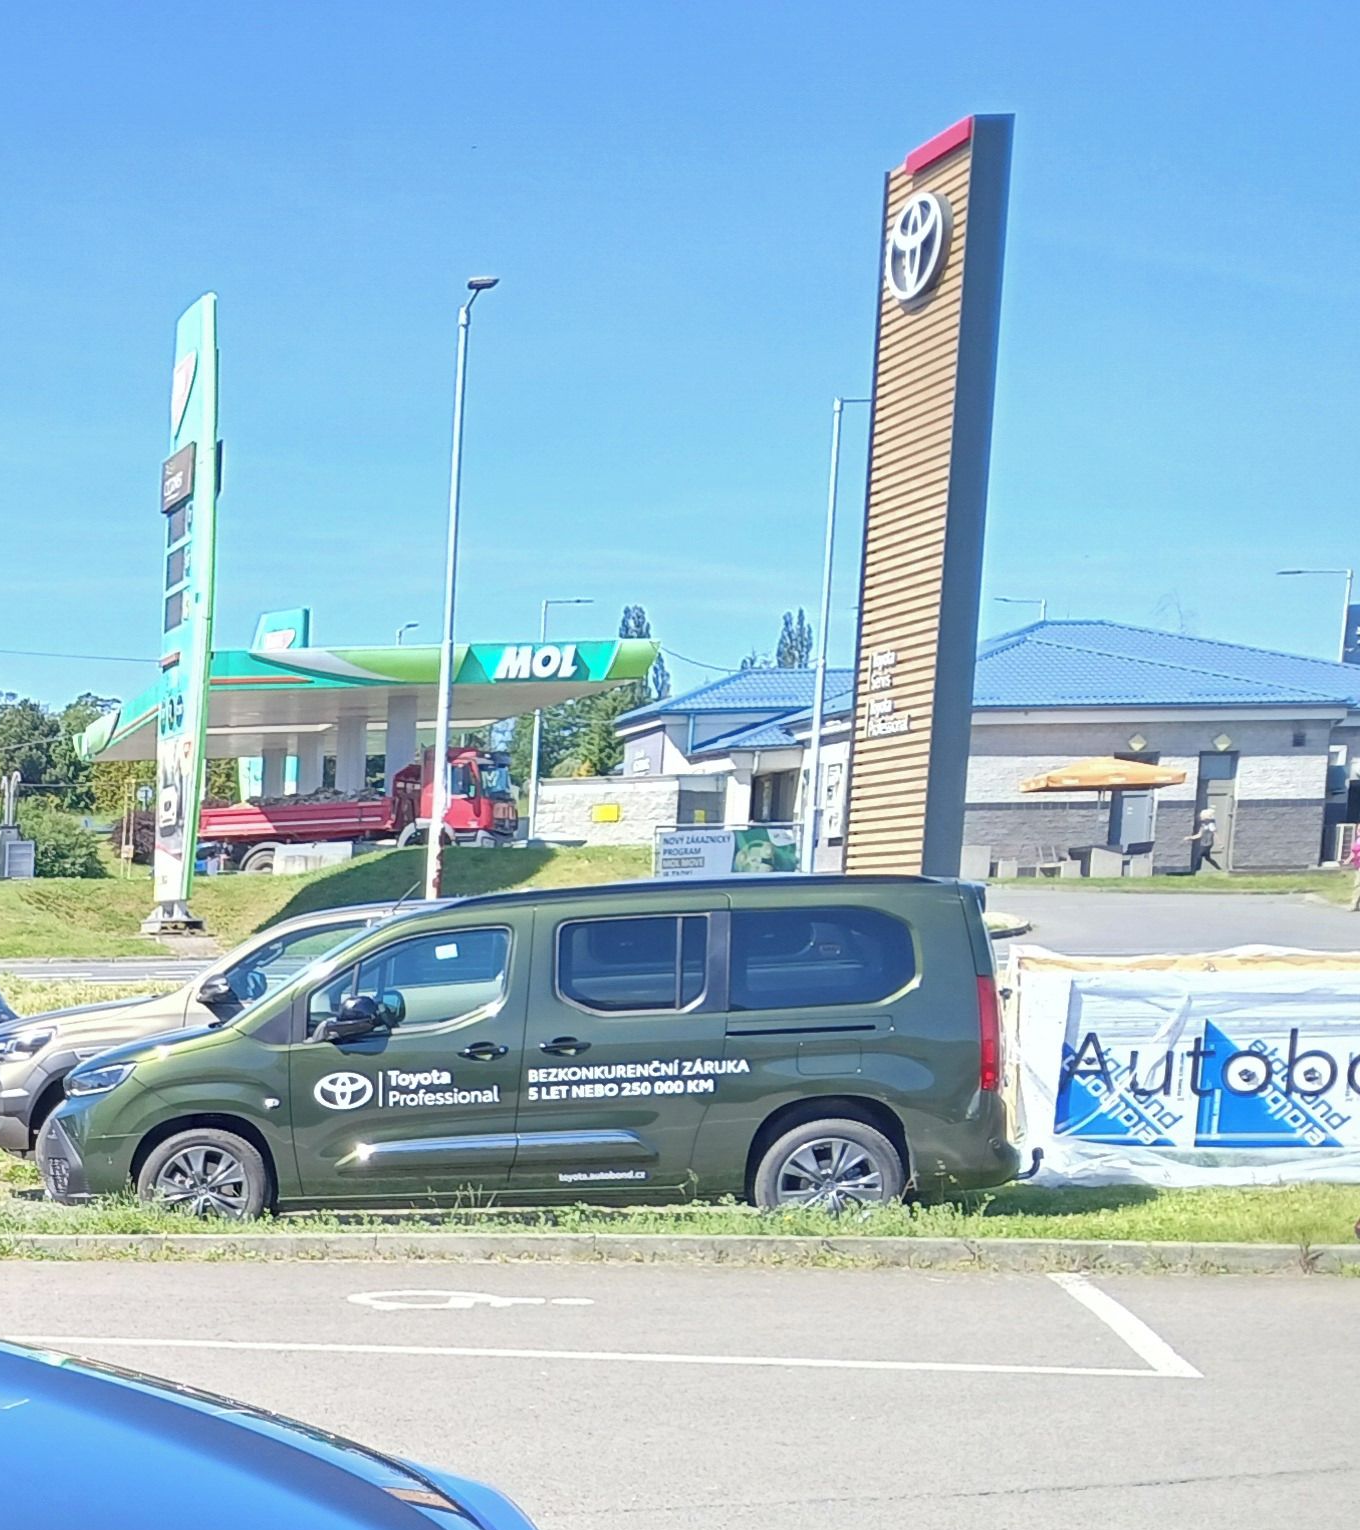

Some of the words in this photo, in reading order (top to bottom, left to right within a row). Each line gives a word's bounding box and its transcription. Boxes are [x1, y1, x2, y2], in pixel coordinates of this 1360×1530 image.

[493, 644, 578, 679] MOL
[528, 1060, 680, 1082] BEZKONKURENČNÍ
[681, 1058, 750, 1075] ZÁRUKA
[1059, 1028, 1360, 1097] Autob
[387, 1069, 452, 1089] Toyota
[528, 1086, 539, 1100] 5
[541, 1085, 569, 1099] LET
[571, 1083, 619, 1098] NEBO
[621, 1081, 651, 1096] 250
[654, 1080, 684, 1095] 000
[686, 1079, 714, 1093] KM
[388, 1085, 500, 1107] Professional
